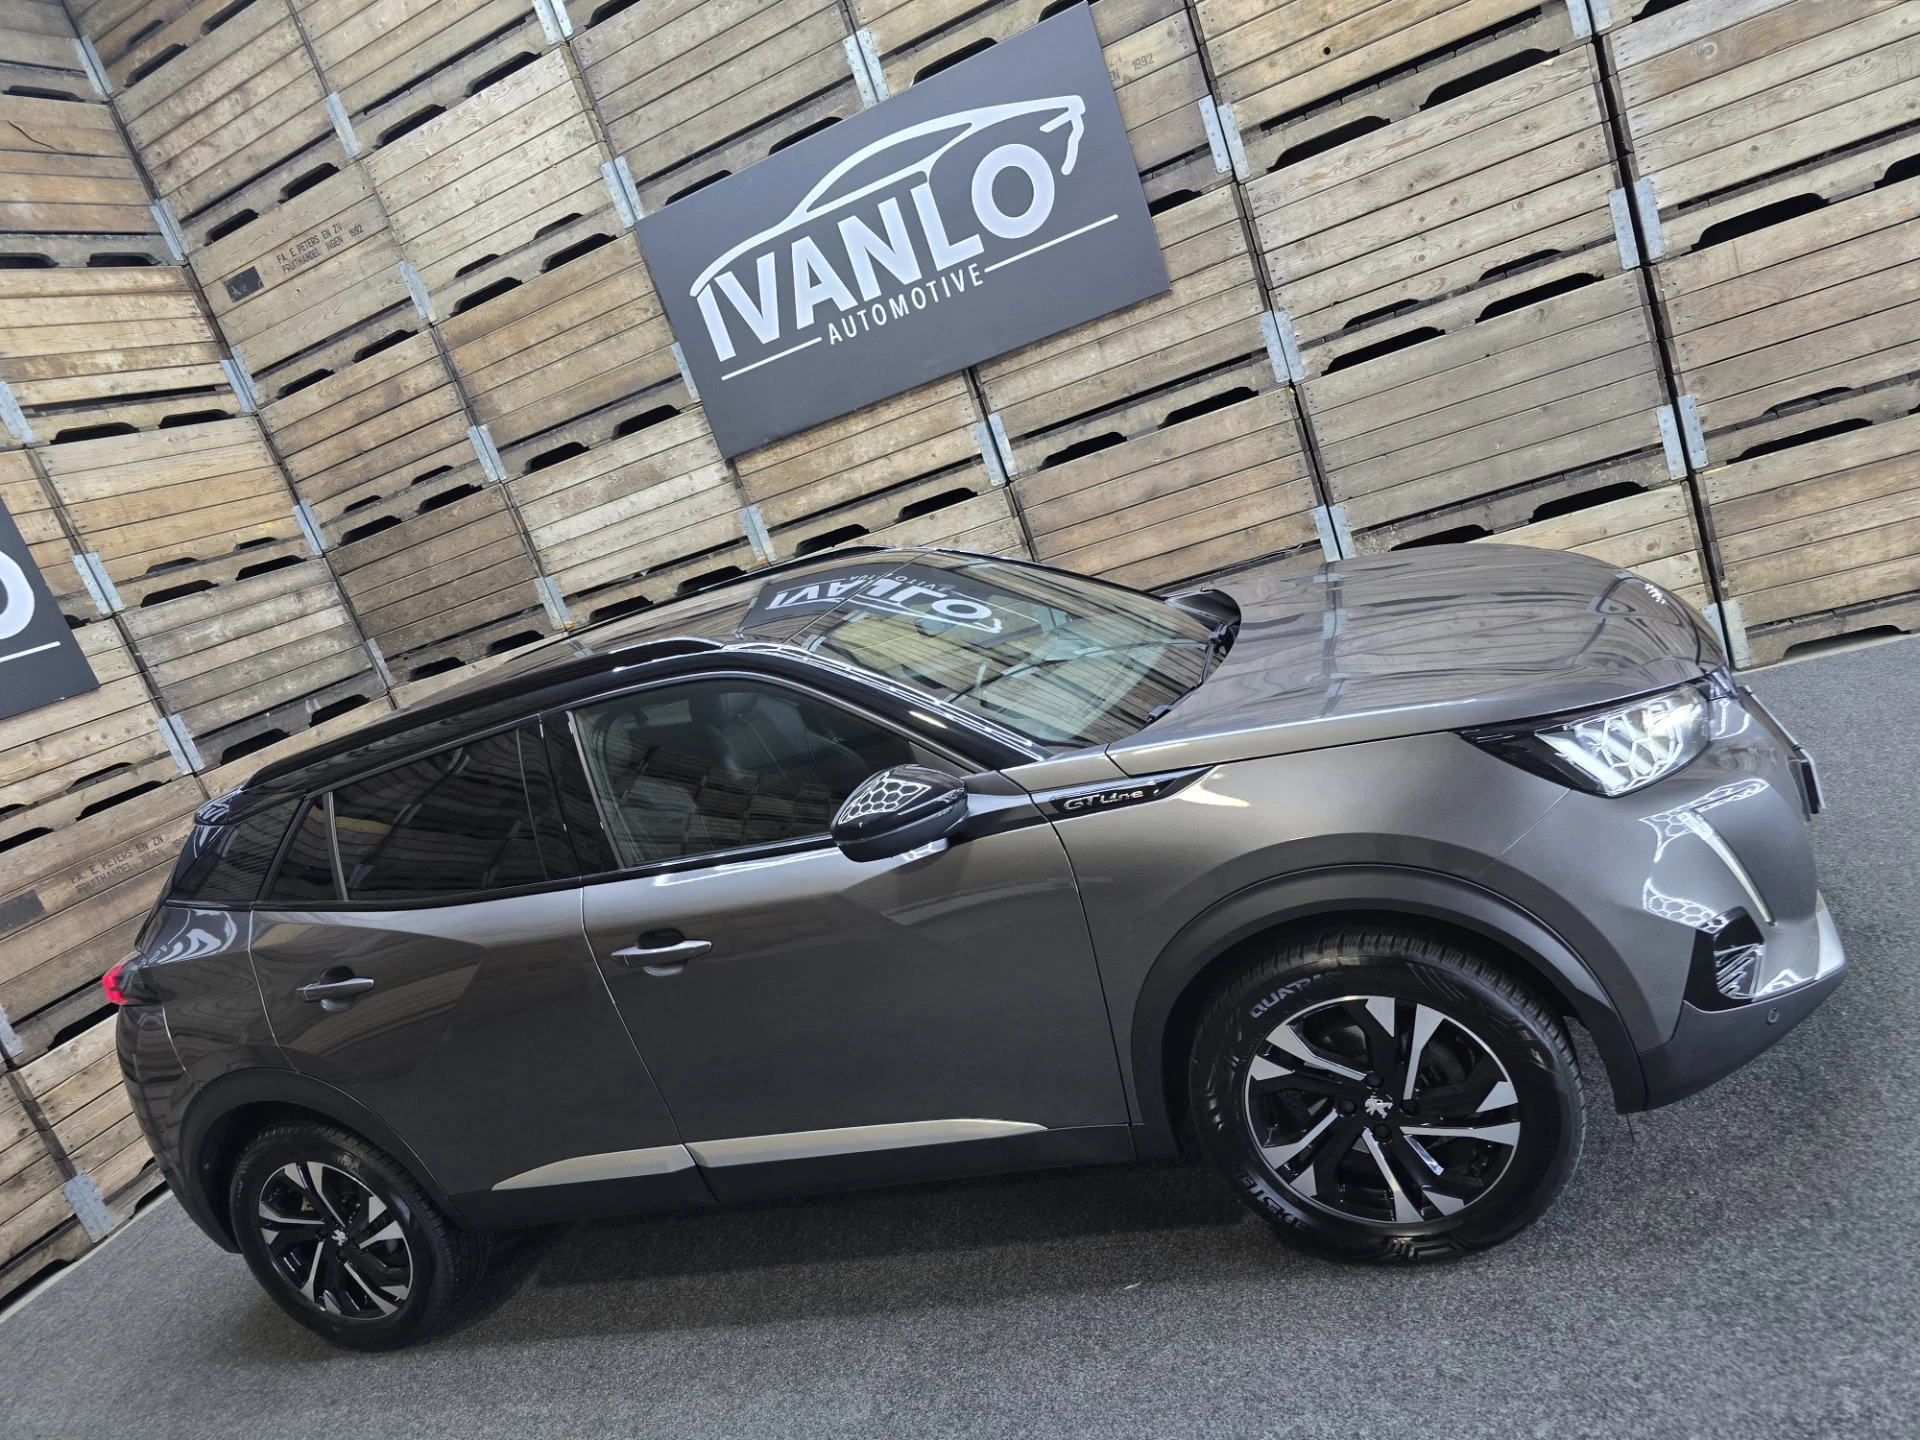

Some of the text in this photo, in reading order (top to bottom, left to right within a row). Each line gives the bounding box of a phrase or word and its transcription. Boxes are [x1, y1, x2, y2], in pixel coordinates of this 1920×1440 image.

[1131, 52, 1155, 71] 1992
[296, 234, 320, 251] PETERS
[321, 227, 332, 239] EN
[696, 143, 1056, 362] IVANLO
[282, 249, 322, 274] FRUITHANDEL
[828, 263, 985, 345] AUTOMOTIVE
[100, 850, 134, 868] PETERS
[137, 841, 149, 853] EN
[150, 833, 164, 847] ZN
